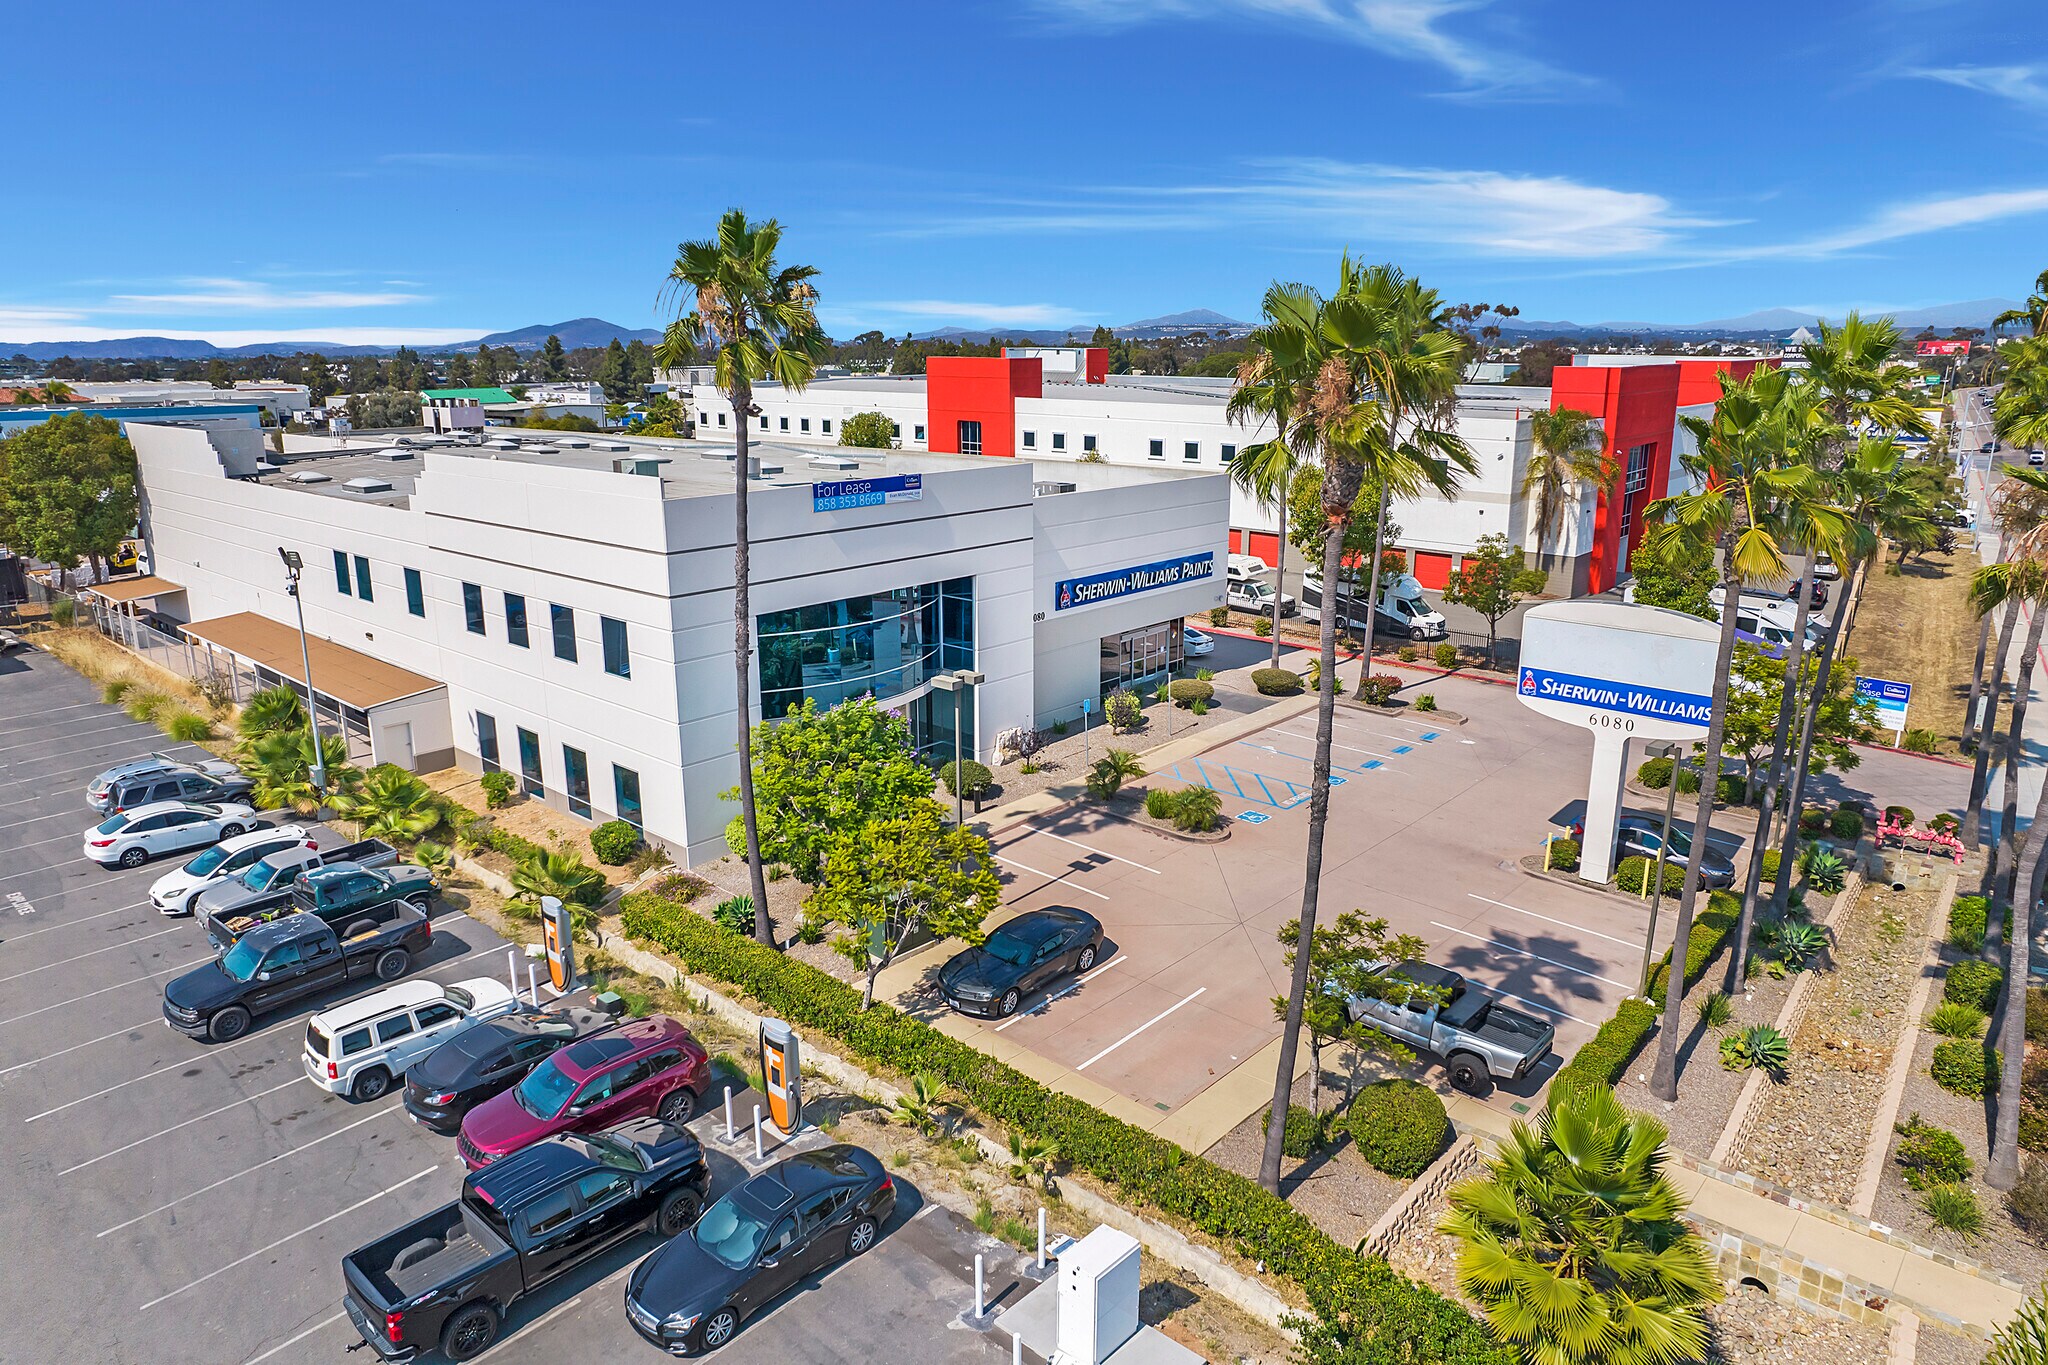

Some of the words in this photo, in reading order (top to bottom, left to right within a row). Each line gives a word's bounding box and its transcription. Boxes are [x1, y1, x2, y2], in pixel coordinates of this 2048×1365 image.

[817, 485, 836, 497] For
[839, 482, 872, 495] Lease
[817, 498, 837, 511] 858
[839, 495, 857, 508] 353
[859, 492, 883, 506] 8669
[1074, 567, 1178, 603] SHERWIN-WILLIAMS
[1182, 559, 1214, 580] PAINTS
[1857, 680, 1873, 689] For
[1540, 677, 1712, 722] SHERWIN-WILLIAMS
[1589, 713, 1634, 732] 6080
